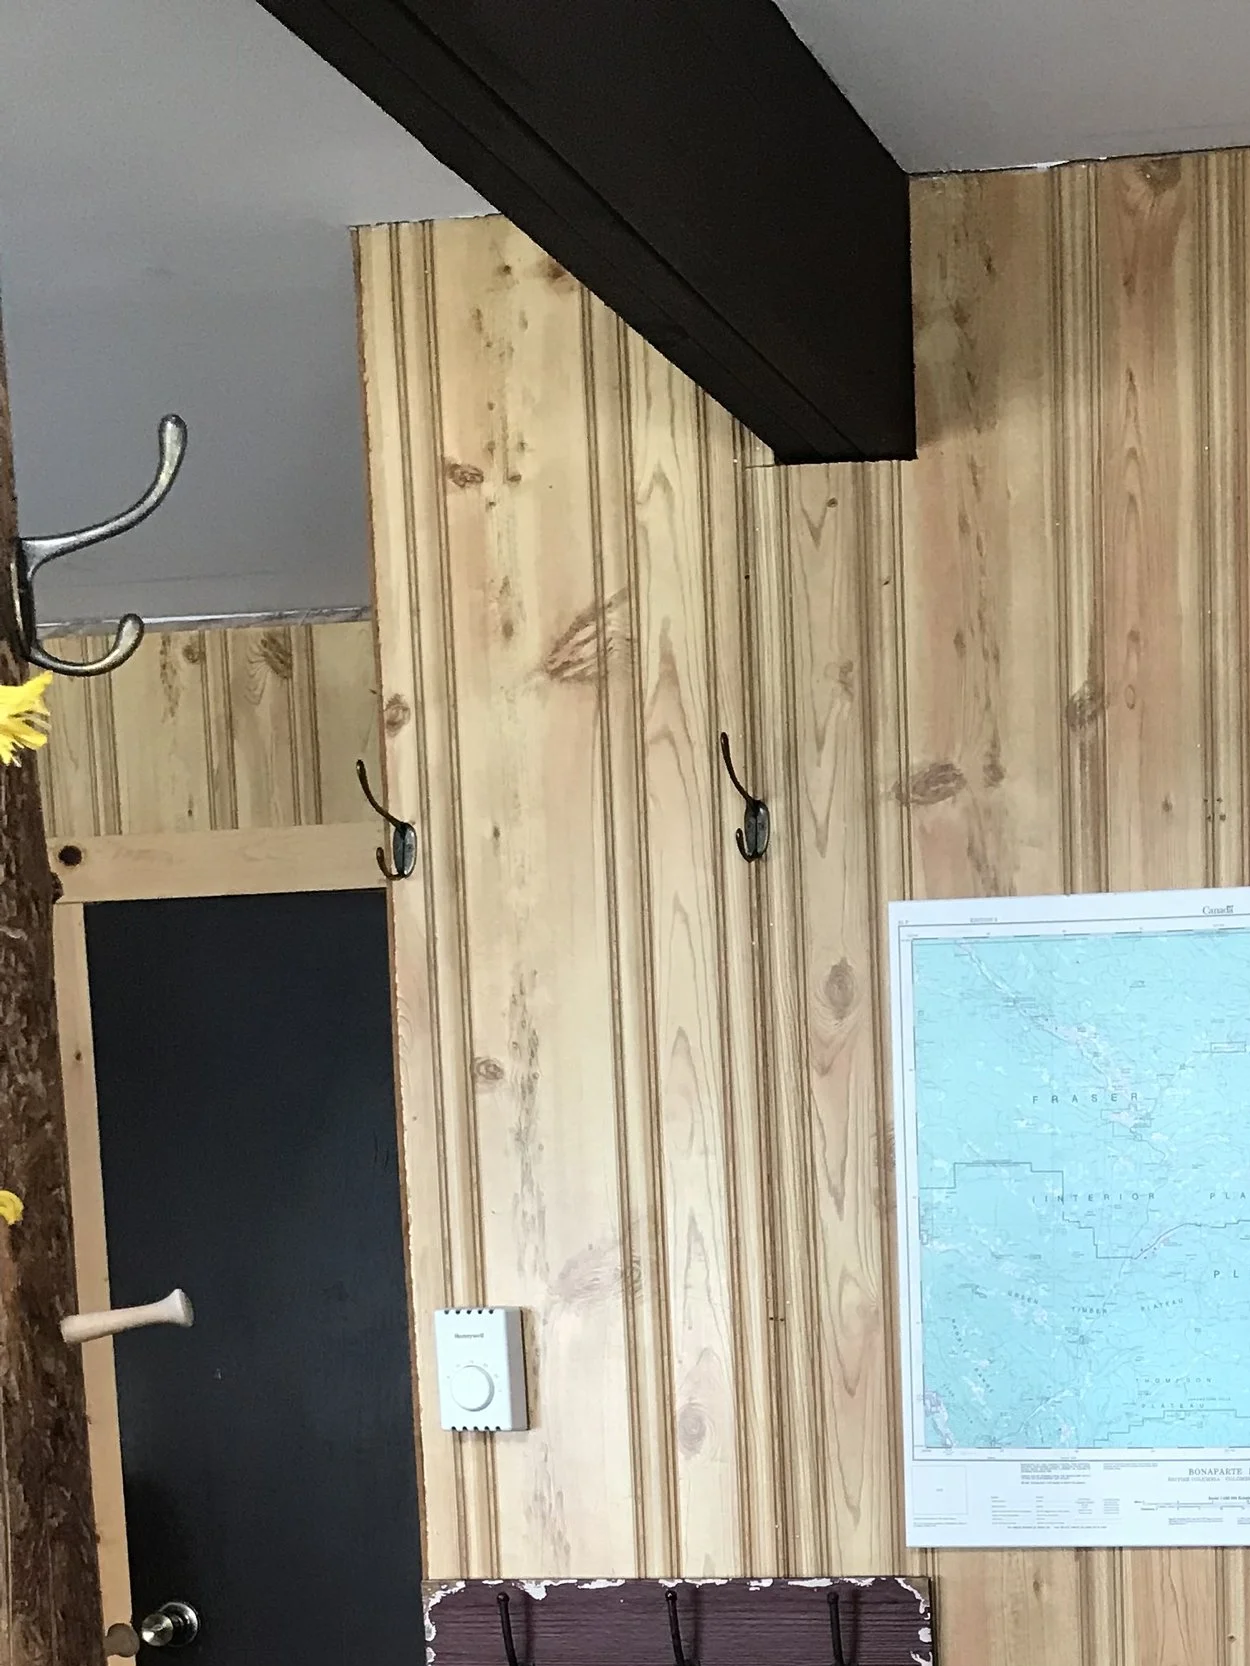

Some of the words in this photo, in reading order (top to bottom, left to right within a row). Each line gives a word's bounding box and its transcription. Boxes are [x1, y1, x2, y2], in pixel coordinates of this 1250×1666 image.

[1202, 905, 1234, 914] Canada
[1033, 1092, 1138, 1104] FRASER
[1072, 1306, 1107, 1315] TIMBER
[1188, 1467, 1243, 1476] BONAPARTE
